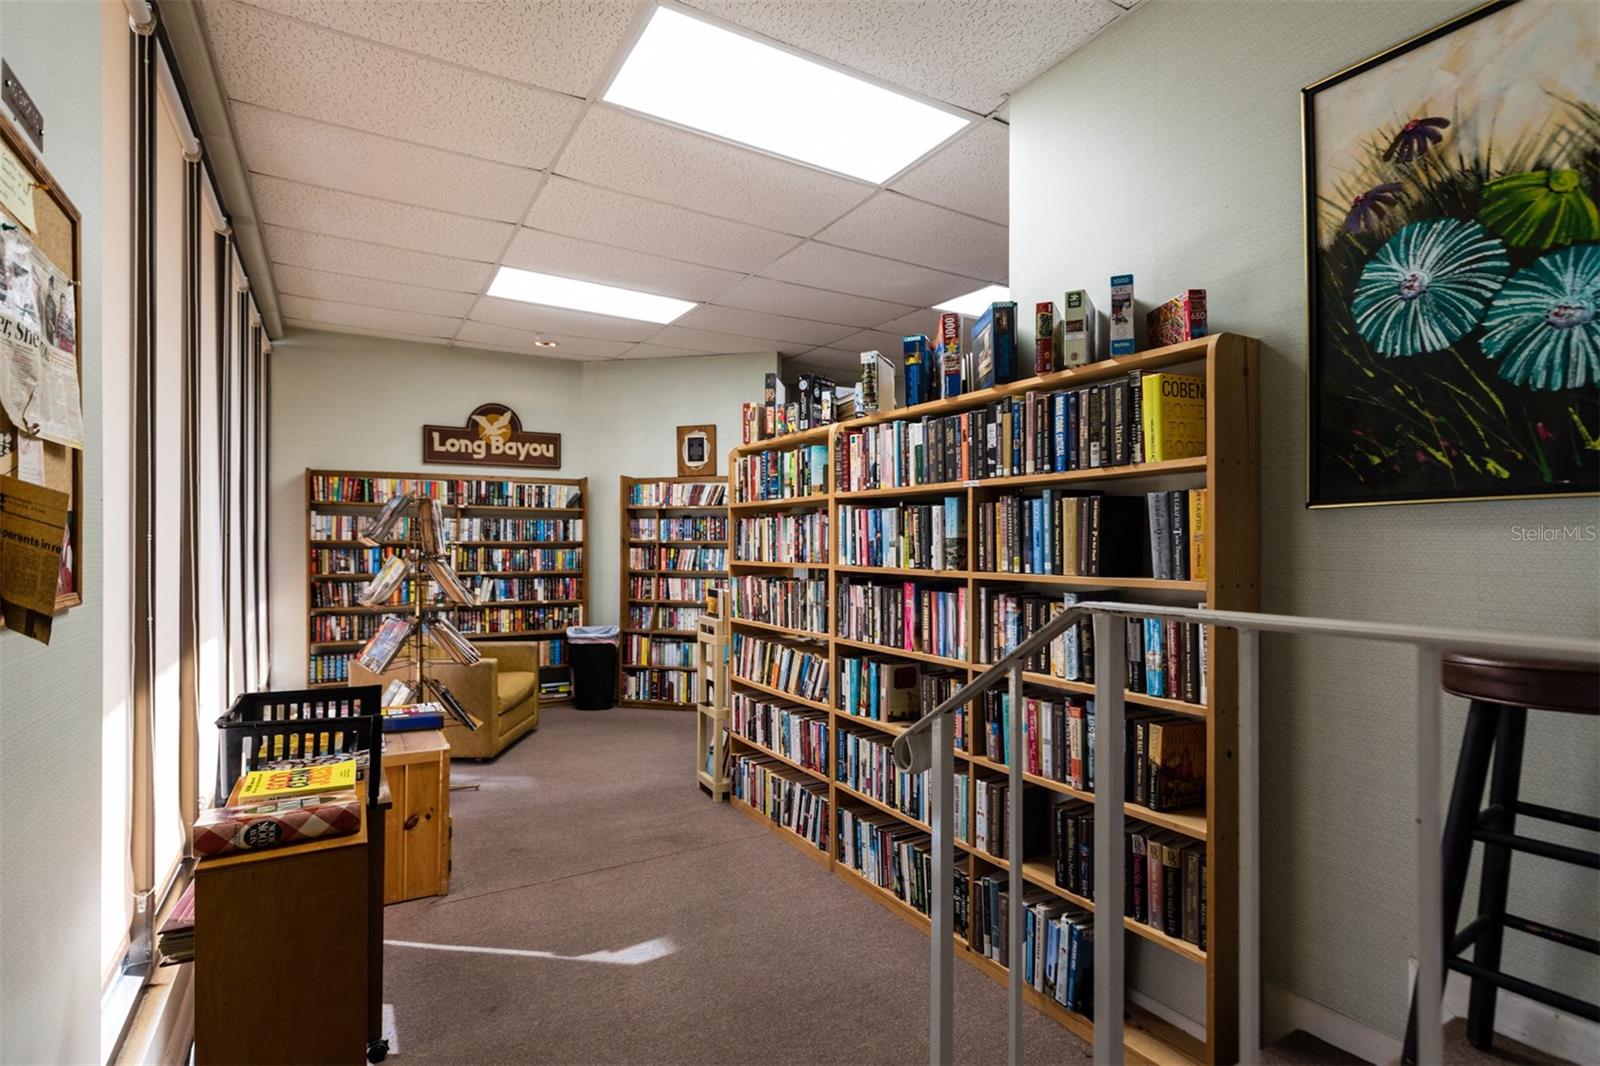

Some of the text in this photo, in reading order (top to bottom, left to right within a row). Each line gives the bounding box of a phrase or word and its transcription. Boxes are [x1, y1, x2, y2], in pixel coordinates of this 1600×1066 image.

[1190, 311, 1206, 320] 650
[15, 321, 40, 348] She
[944, 317, 956, 339] 1000
[1161, 380, 1204, 399] COBEN
[1055, 415, 1064, 433] COOK
[432, 431, 554, 461] Long Bayou
[41, 538, 51, 550] in
